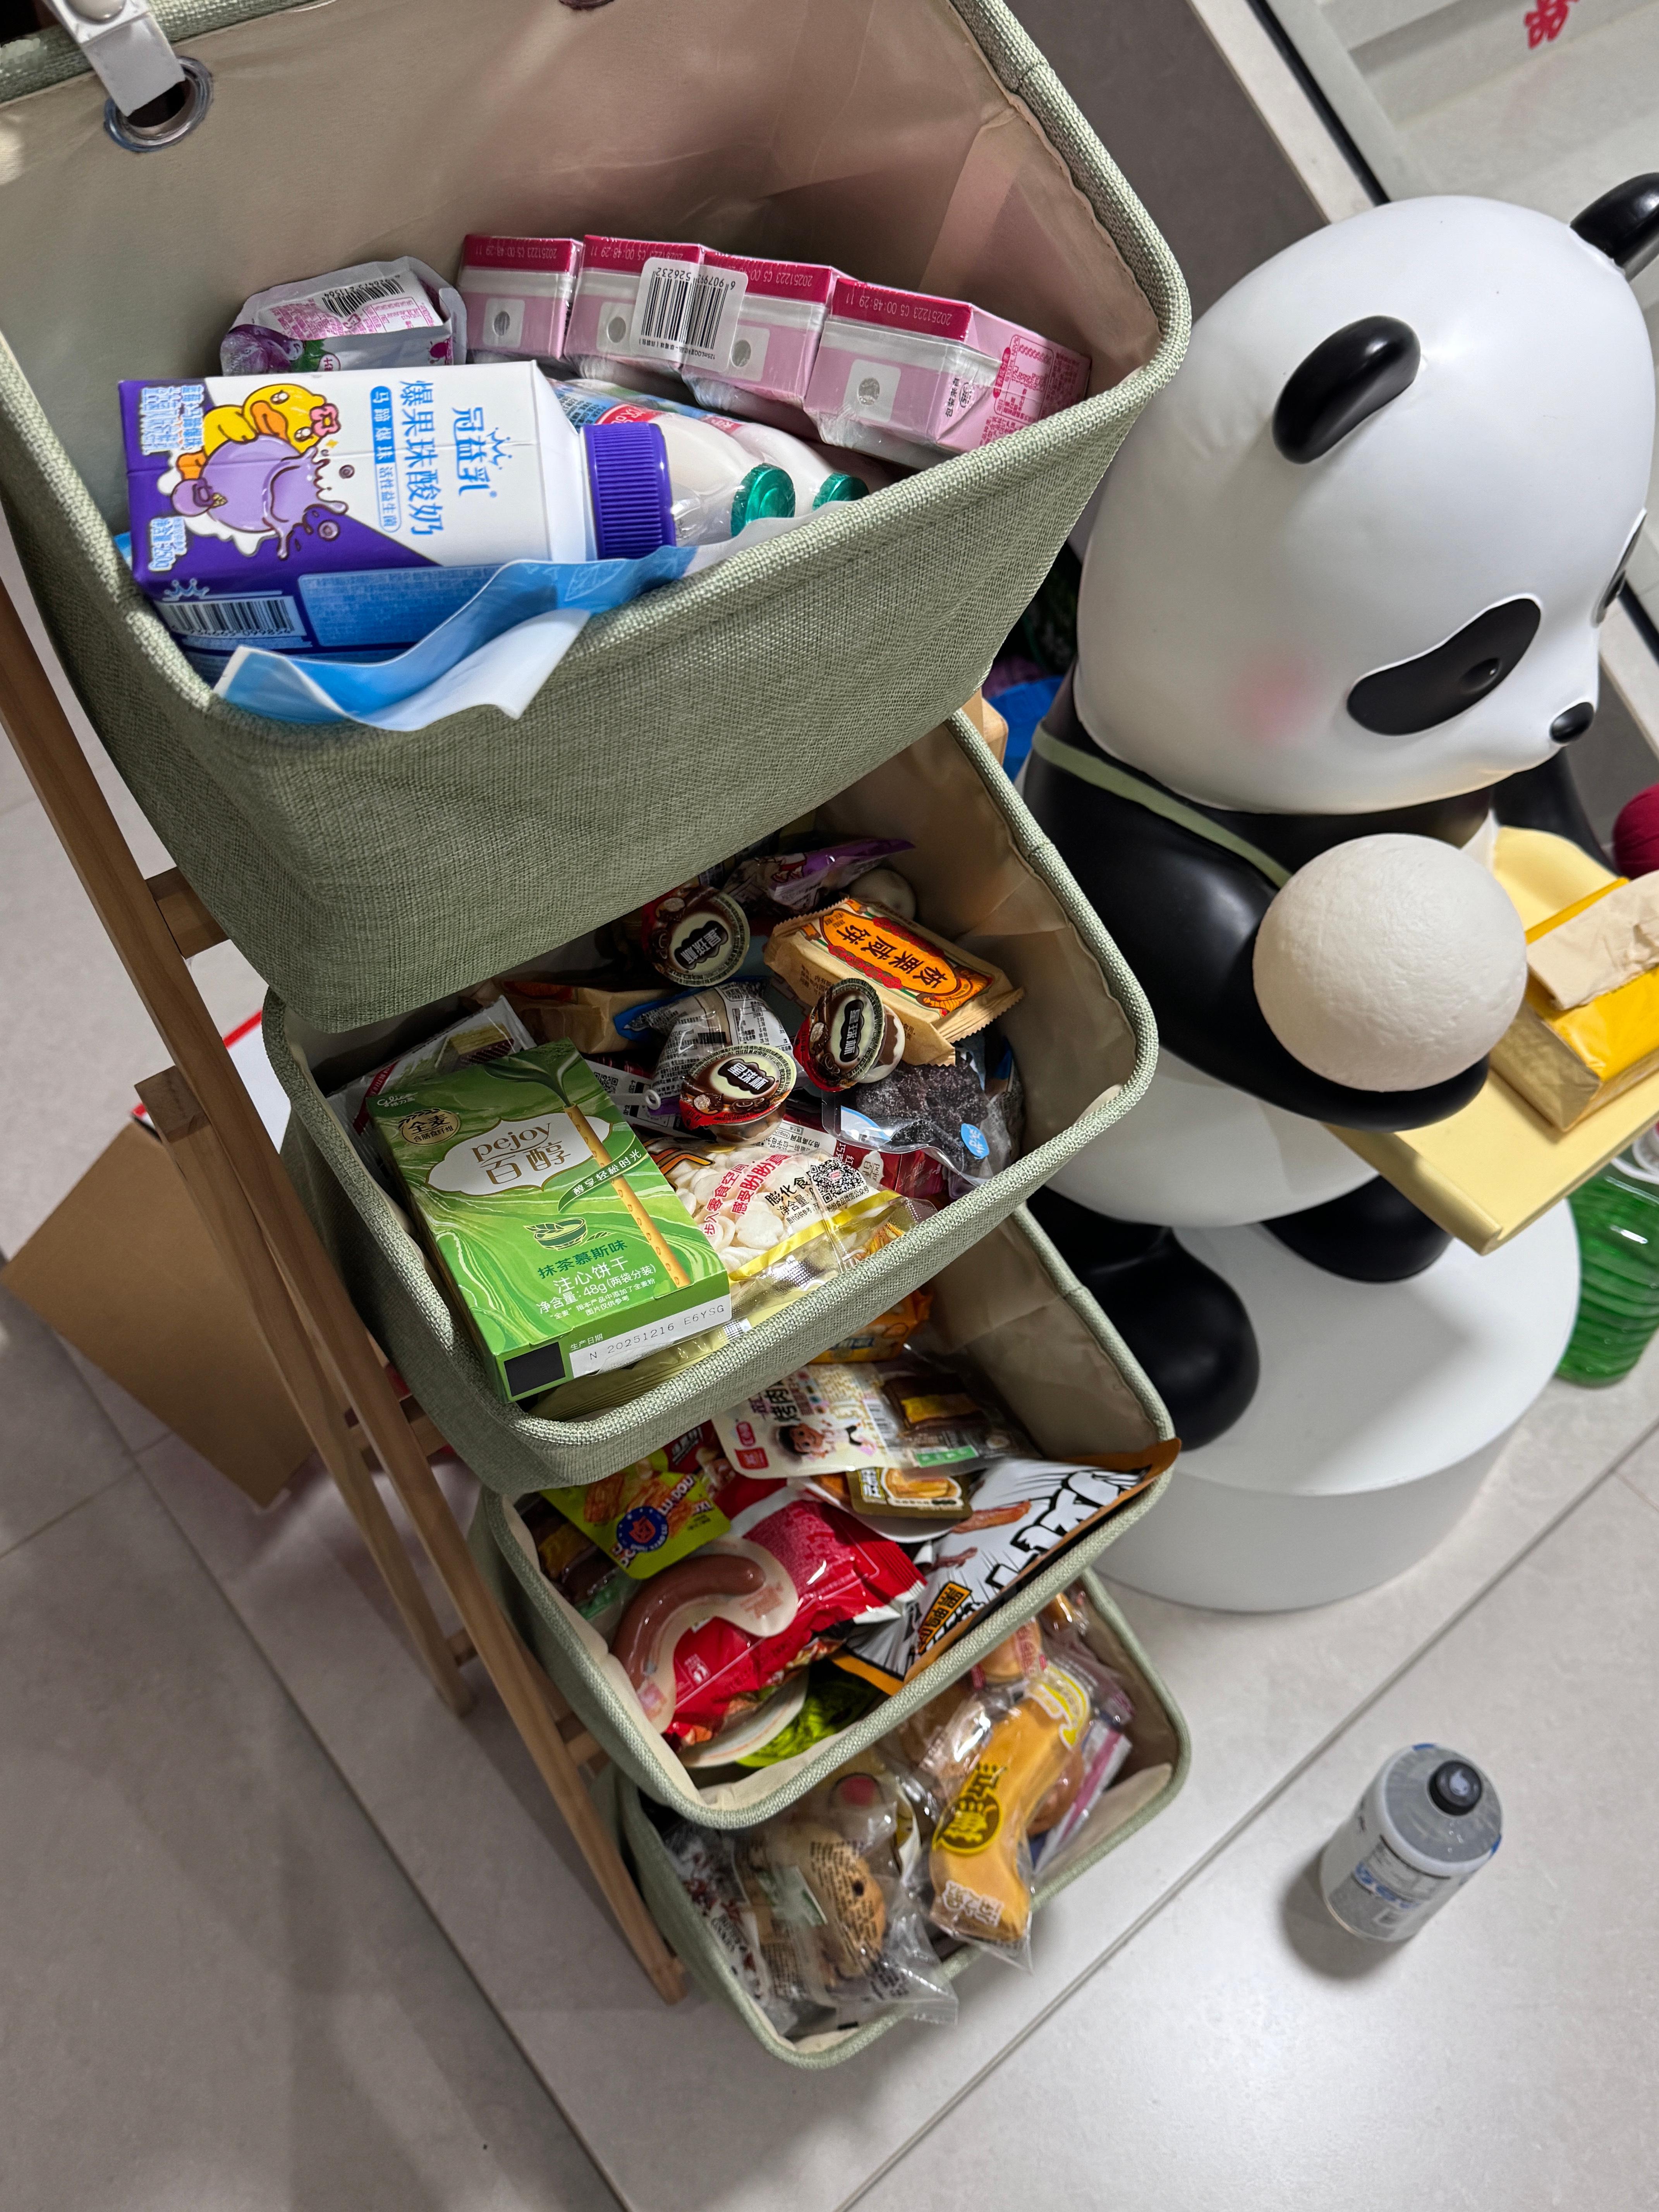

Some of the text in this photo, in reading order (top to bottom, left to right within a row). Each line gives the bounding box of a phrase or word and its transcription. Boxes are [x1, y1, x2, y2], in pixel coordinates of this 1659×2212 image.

[656, 267, 692, 281] 526232
[776, 273, 813, 287] 20251223
[845, 292, 952, 326] 20251223 C5 00:48:29 11
[373, 390, 393, 461] 马蹄爆珠
[399, 380, 444, 536] 爆果珠酸奶
[452, 407, 491, 496] 冠益乳
[379, 466, 397, 527] 活性益生菌
[680, 927, 721, 964] 星球杯
[836, 925, 948, 989] 板栗咸饼
[843, 1008, 860, 1055] 星球杯
[727, 1062, 769, 1091] 星球杯
[408, 1113, 450, 1135] 全麦
[414, 1125, 454, 1142] 含膳食纤维
[471, 1122, 551, 1163] pejoy
[790, 1134, 820, 1149] 格力高官网
[480, 1140, 571, 1185] 百醇
[573, 1149, 642, 1196] 醇享轻松时光
[704, 1164, 750, 1236] 步入零食空间
[776, 1187, 816, 1216] 净含量:
[537, 1240, 628, 1279] 抹茶慕斯味
[553, 1256, 629, 1294] 注心饼干
[575, 1278, 656, 1312] 指本产品中添加了全麦粉
[585, 1295, 630, 1316] 图片仅供参考
[570, 1333, 603, 1351] 生产日期
[589, 1304, 725, 1360] N 20251216 E6YSG
